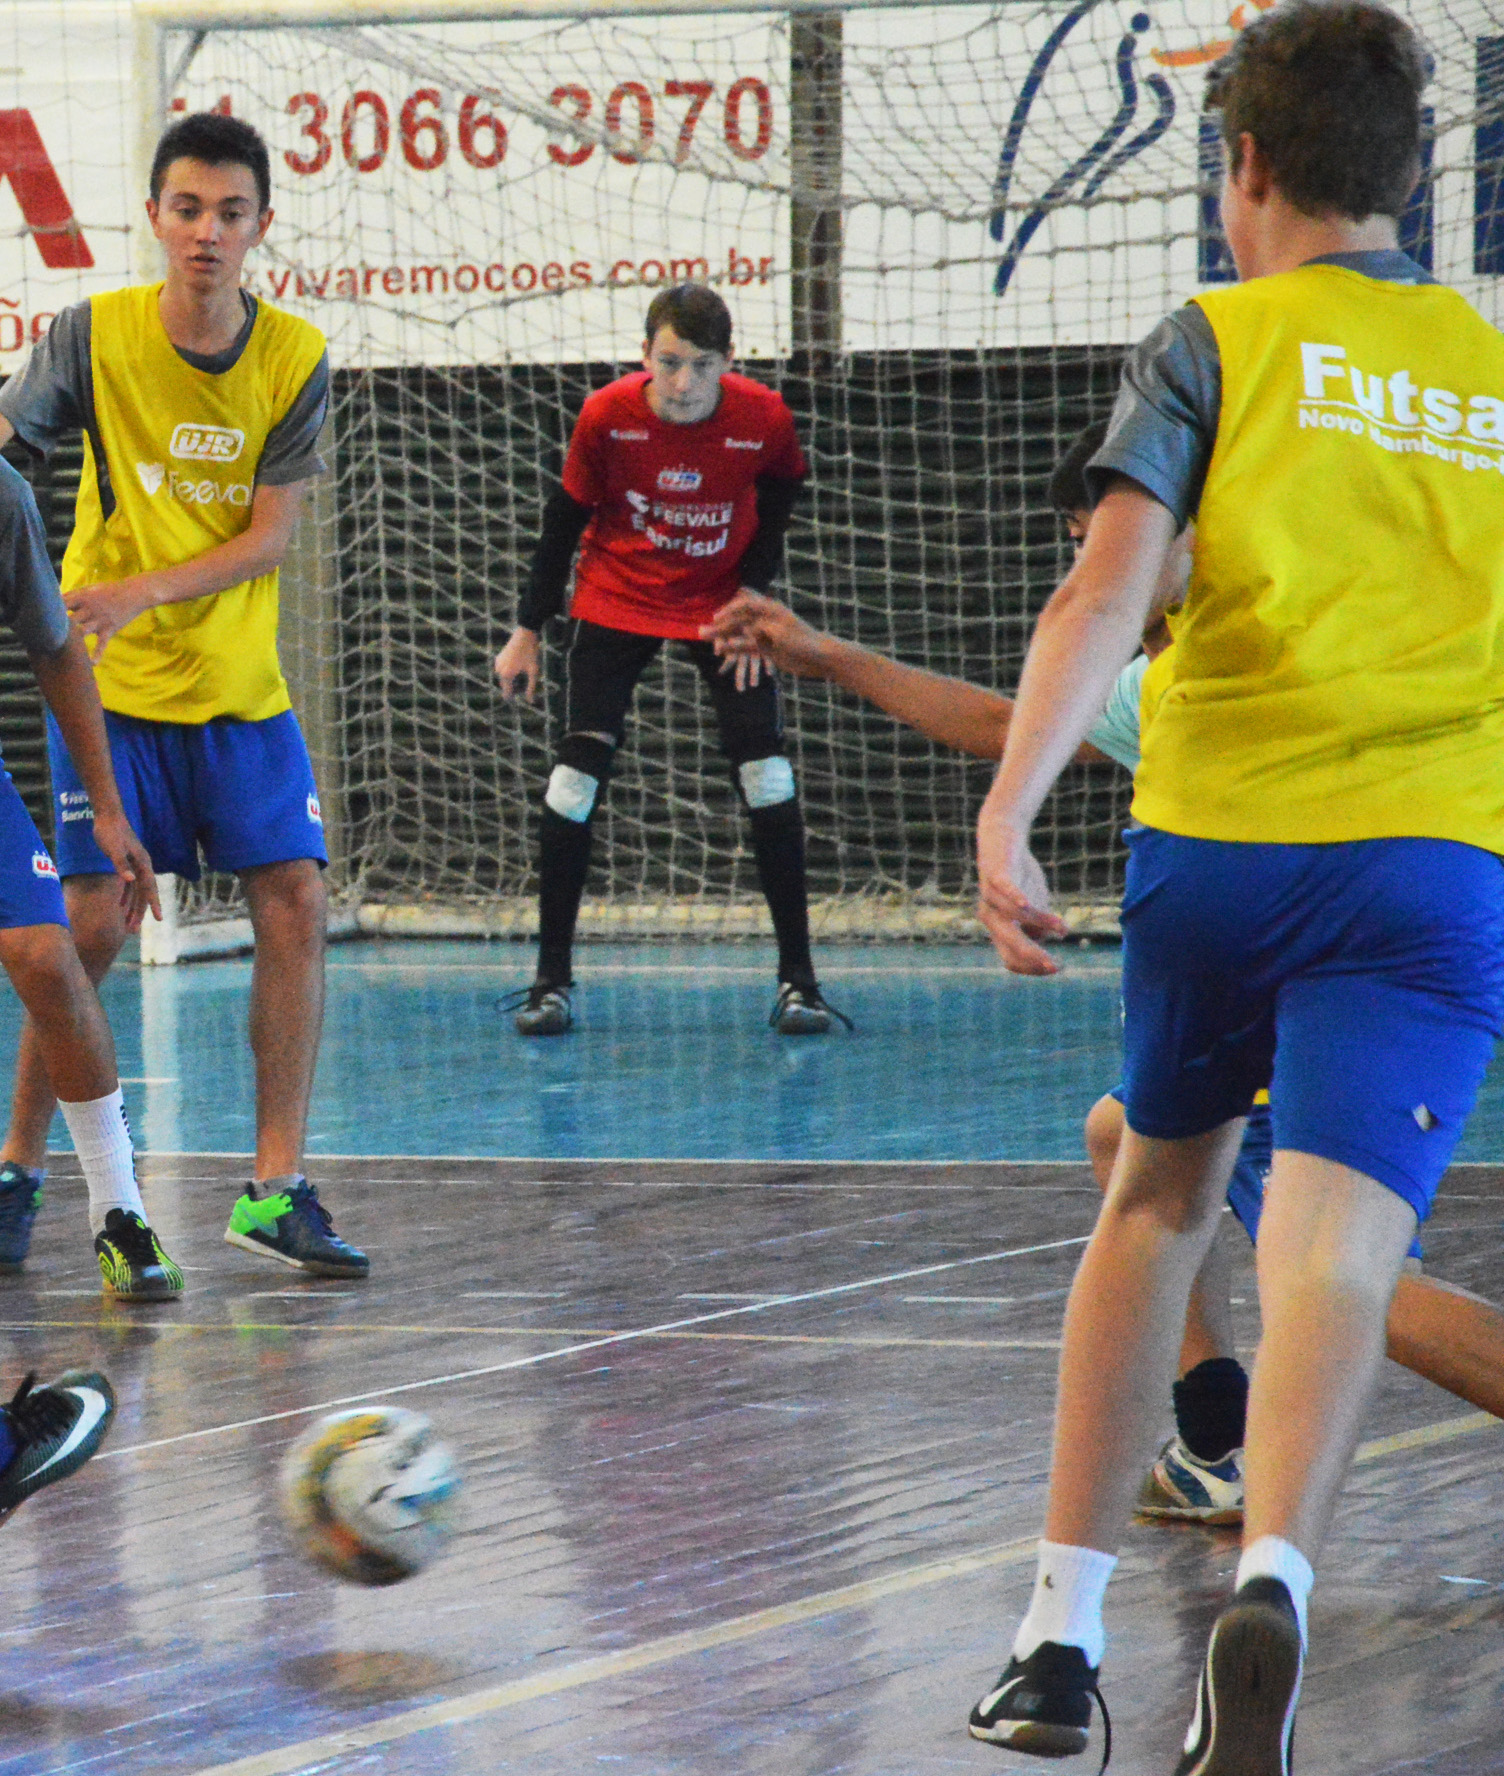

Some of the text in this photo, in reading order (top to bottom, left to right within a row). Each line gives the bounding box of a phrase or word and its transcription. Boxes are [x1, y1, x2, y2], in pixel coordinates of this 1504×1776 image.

[283, 77, 773, 175] 3066 3070
[1299, 408, 1364, 435] Novo
